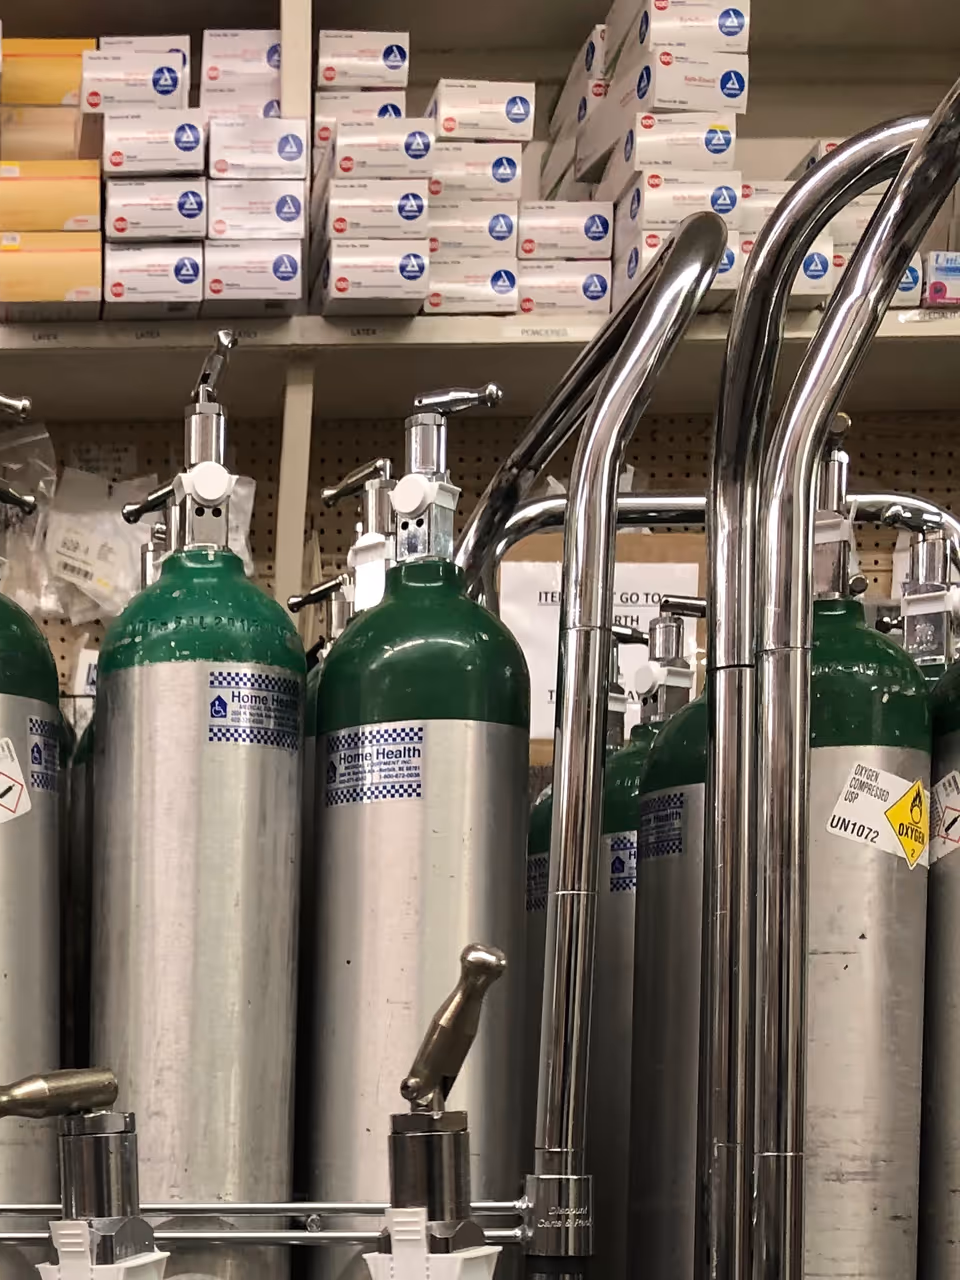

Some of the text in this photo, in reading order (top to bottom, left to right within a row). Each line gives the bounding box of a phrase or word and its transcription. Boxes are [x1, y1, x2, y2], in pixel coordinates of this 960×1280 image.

[620, 592, 640, 604] GO
[642, 592, 662, 604] TO
[231, 691, 269, 705] Home
[339, 746, 421, 766] Home Health
[843, 790, 859, 804] USP
[849, 777, 890, 803] COMPRESSED
[829, 814, 880, 844] UN1072
[898, 822, 925, 846] OXYGEN
[910, 848, 916, 858] 2
